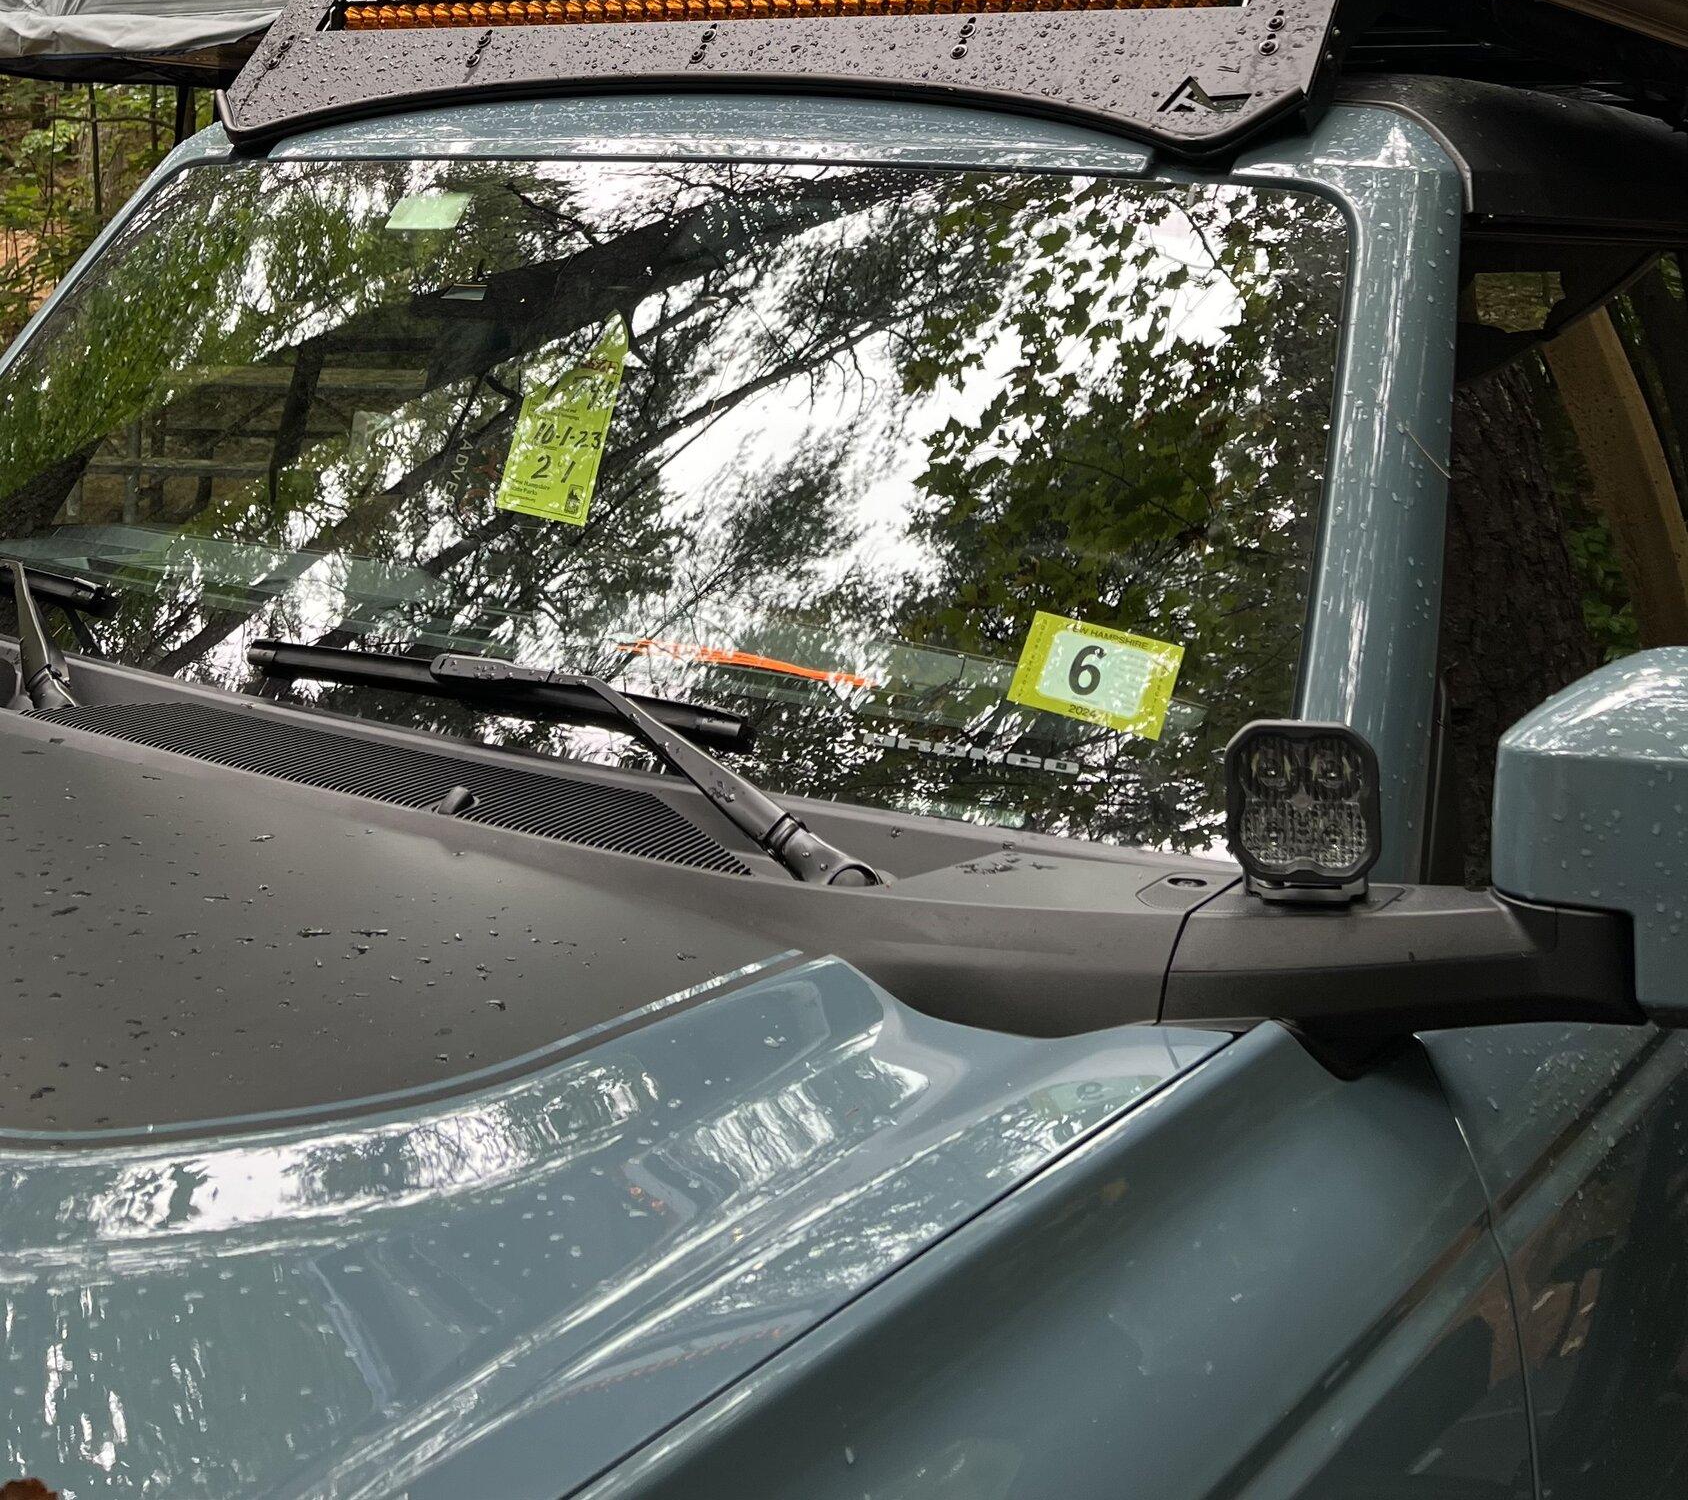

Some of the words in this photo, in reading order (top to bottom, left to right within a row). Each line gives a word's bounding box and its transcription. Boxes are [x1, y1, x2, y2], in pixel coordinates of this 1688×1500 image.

[533, 422, 602, 450] 10-1-23
[1091, 627, 1149, 650] HAMPSHIRE
[1069, 645, 1107, 696] 6
[1068, 704, 1096, 718] 2024
